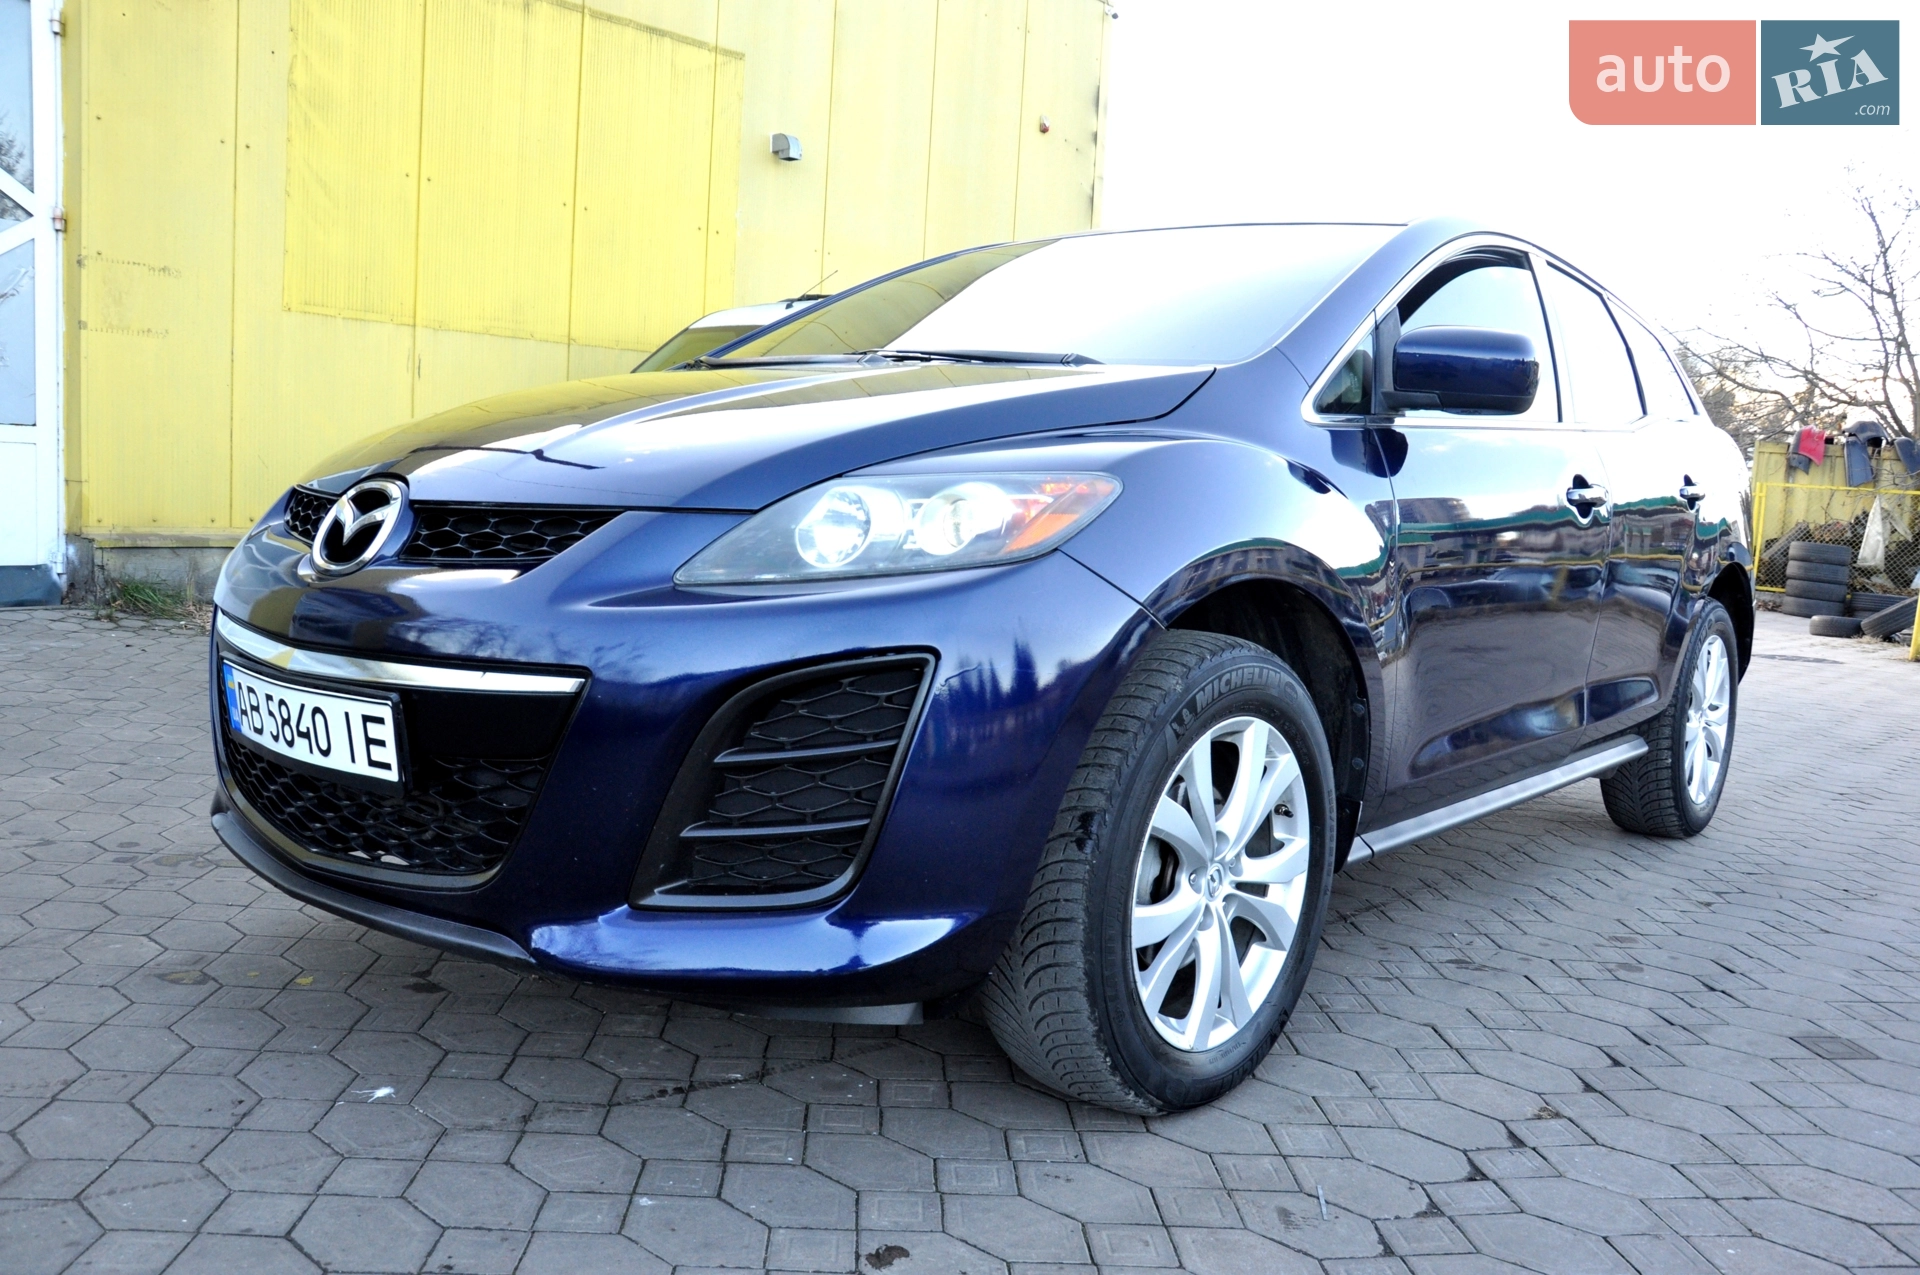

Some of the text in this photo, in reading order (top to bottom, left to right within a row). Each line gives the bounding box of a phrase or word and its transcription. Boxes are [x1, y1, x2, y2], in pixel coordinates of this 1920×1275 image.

[1195, 667, 1281, 713] MICHELIN
[237, 681, 393, 771] AB 5840 IE
